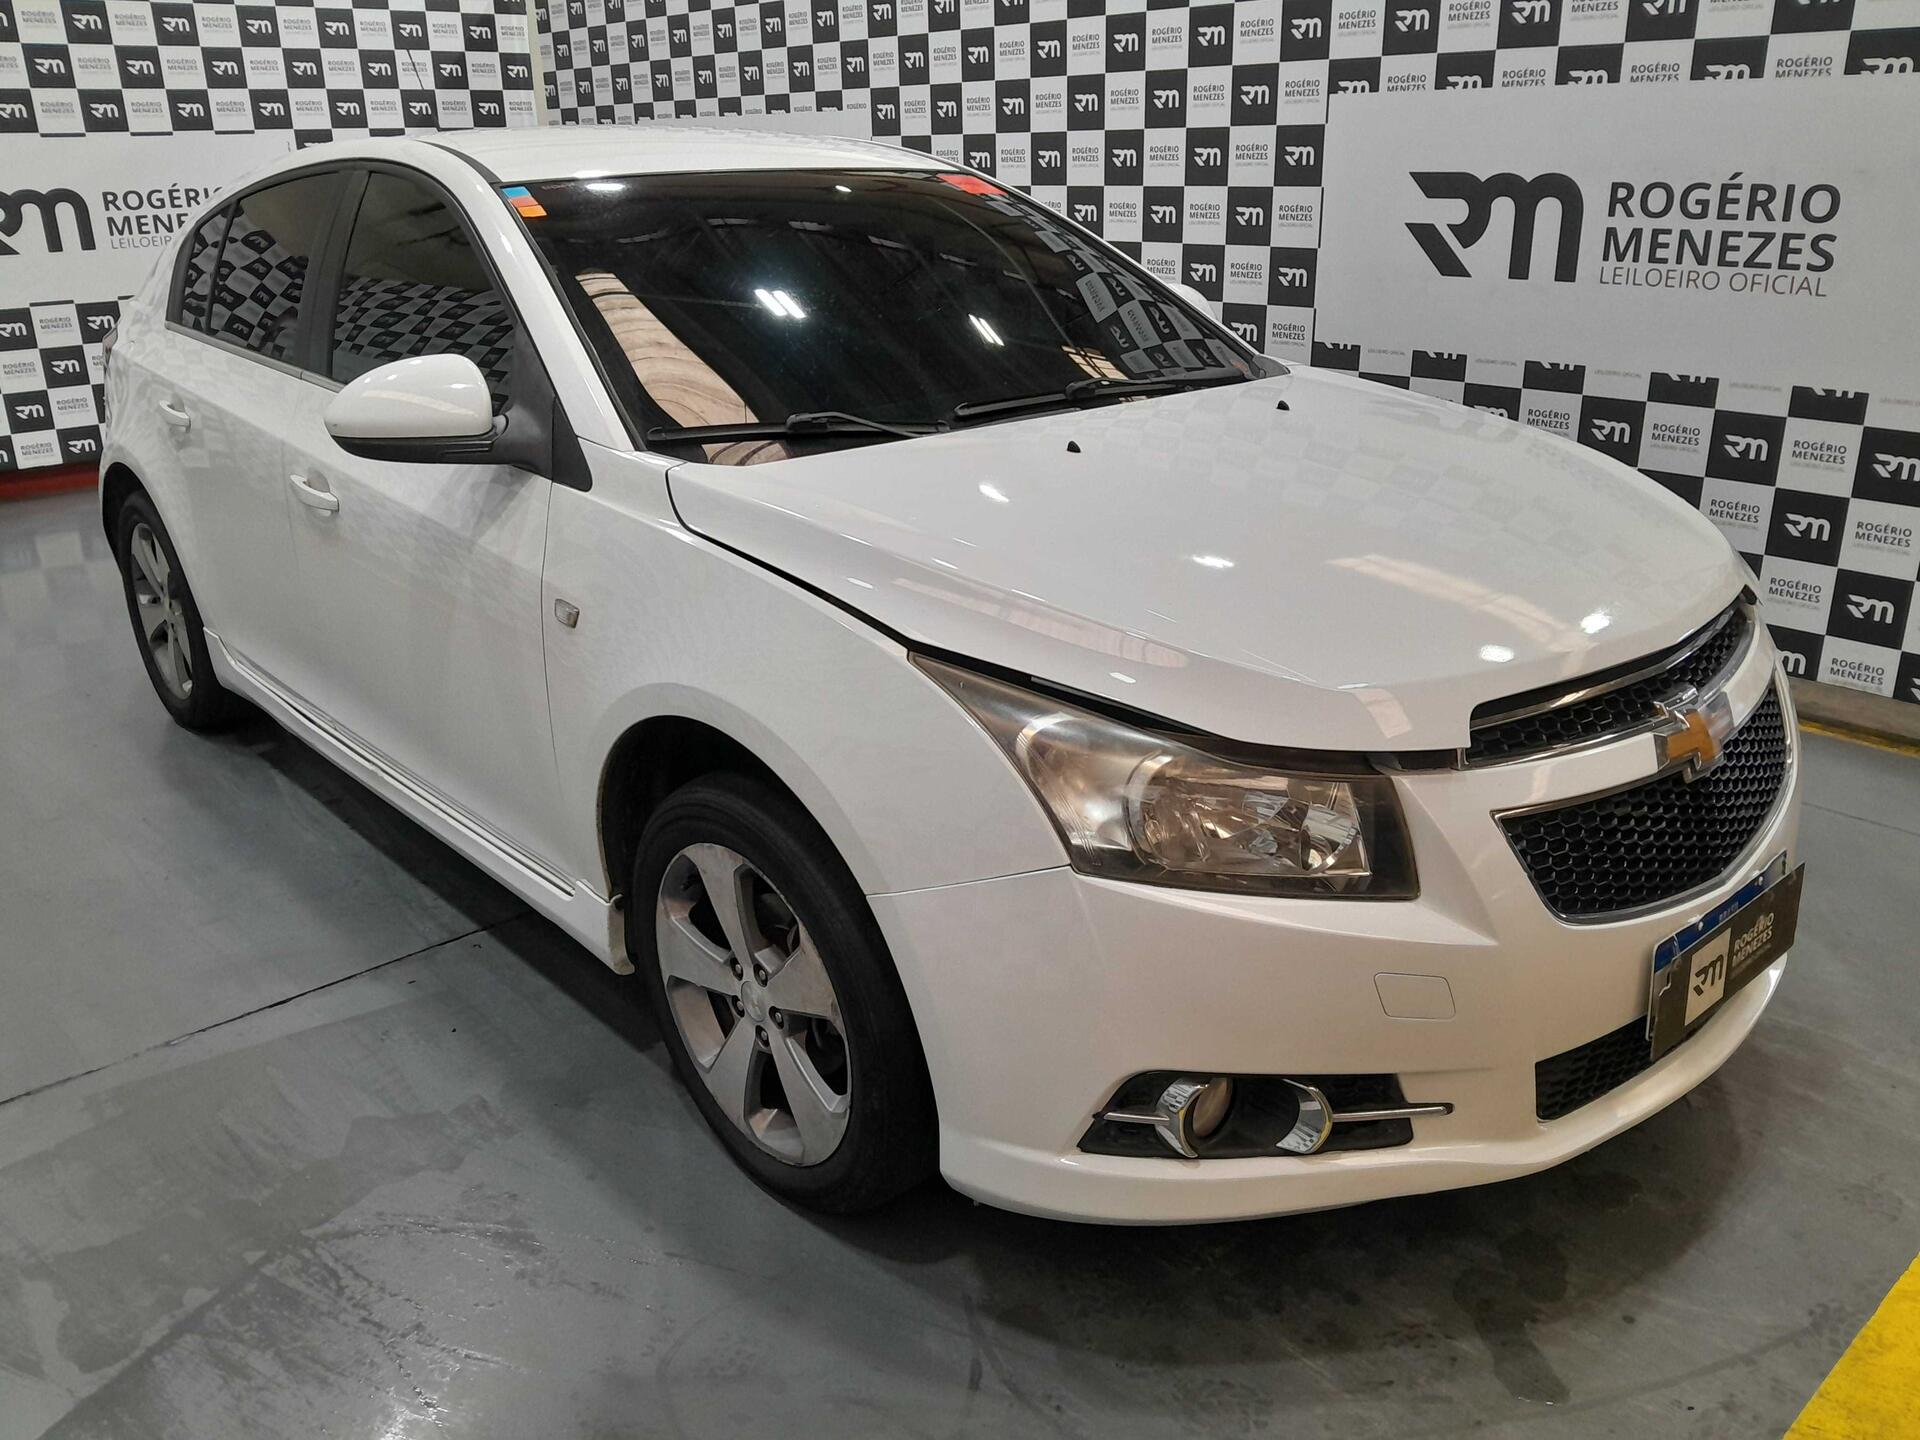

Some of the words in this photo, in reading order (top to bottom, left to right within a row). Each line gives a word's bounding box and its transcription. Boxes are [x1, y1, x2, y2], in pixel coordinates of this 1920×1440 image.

[1571, 1, 1618, 13] MENEZES
[1339, 10, 1376, 20] ROGÉRIO
[1448, 11, 1490, 21] MENEZES
[1240, 18, 1274, 28] ROGÉRIO
[1338, 19, 1376, 29] MENEZES
[1152, 26, 1182, 36] ROGÉRIO
[1240, 27, 1274, 37] MENEZES
[1072, 34, 1099, 42] ROGÉRIO
[1152, 35, 1182, 44] MENEZES
[1073, 42, 1099, 50] MENEZES
[1000, 48, 1025, 56] MENEZES
[1777, 55, 1833, 68] ROGÉRIO
[1631, 61, 1680, 74] ROGÉRIO
[1388, 73, 1426, 84] ROGÉRIO
[1503, 68, 1546, 79] ROGÉRIO
[1193, 83, 1224, 93] ROGÉRIO
[1285, 79, 1320, 88] ROGÉRIO
[1111, 88, 1139, 97] ROGÉRIO
[1193, 93, 1224, 101] MENEZES
[1285, 89, 1320, 97] MENEZES
[967, 96, 990, 104] ROGÉRIO
[1150, 145, 1179, 153] ROGÉRIO
[1236, 144, 1268, 152] ROGÉRIO
[1235, 152, 1268, 160] MENEZES
[1607, 172, 1841, 225] ROGÉRIO
[1109, 202, 1136, 210] ROGÉRIO
[1190, 203, 1220, 211] ROGÉRIO
[1279, 204, 1313, 213] ROGÉRIO
[1189, 211, 1220, 219] MENEZES
[1279, 213, 1312, 221] MENEZES
[107, 213, 189, 237] MENE
[111, 236, 172, 250] LEILOEIR
[1602, 227, 1838, 273] MENEZES
[1147, 258, 1176, 268] ROGÉRIO
[1231, 262, 1262, 271] ROGÉRIO
[1230, 271, 1262, 279] MENEZES
[1599, 266, 1721, 292] LEILOEIRO
[1729, 272, 1828, 298] OFICIAL
[1273, 323, 1305, 332] ROGÉRIO
[1272, 331, 1305, 340] MENEZES
[1528, 408, 1570, 422] ROGÉRIO
[1526, 417, 1570, 430] MENEZES
[1653, 422, 1700, 437] ROGÉRIO
[1651, 432, 1700, 446] MENEZES
[1794, 440, 1848, 455] ROGÉRIO
[1792, 450, 1846, 465] MENEZES
[1711, 498, 1760, 514] ROGÉRIO
[1709, 508, 1760, 524] MENEZES
[1857, 521, 1912, 538] ROGÉRIO
[1855, 531, 1911, 548] MENEZES
[1770, 578, 1821, 593] ROGÉRIO
[1769, 587, 1820, 603] MENEZES
[1832, 658, 1884, 676] ROGÉRIO
[1830, 667, 1883, 685] MENEZES
[1734, 913, 1775, 950] ROGÉRIO
[1732, 926, 1773, 967] MENEZES
